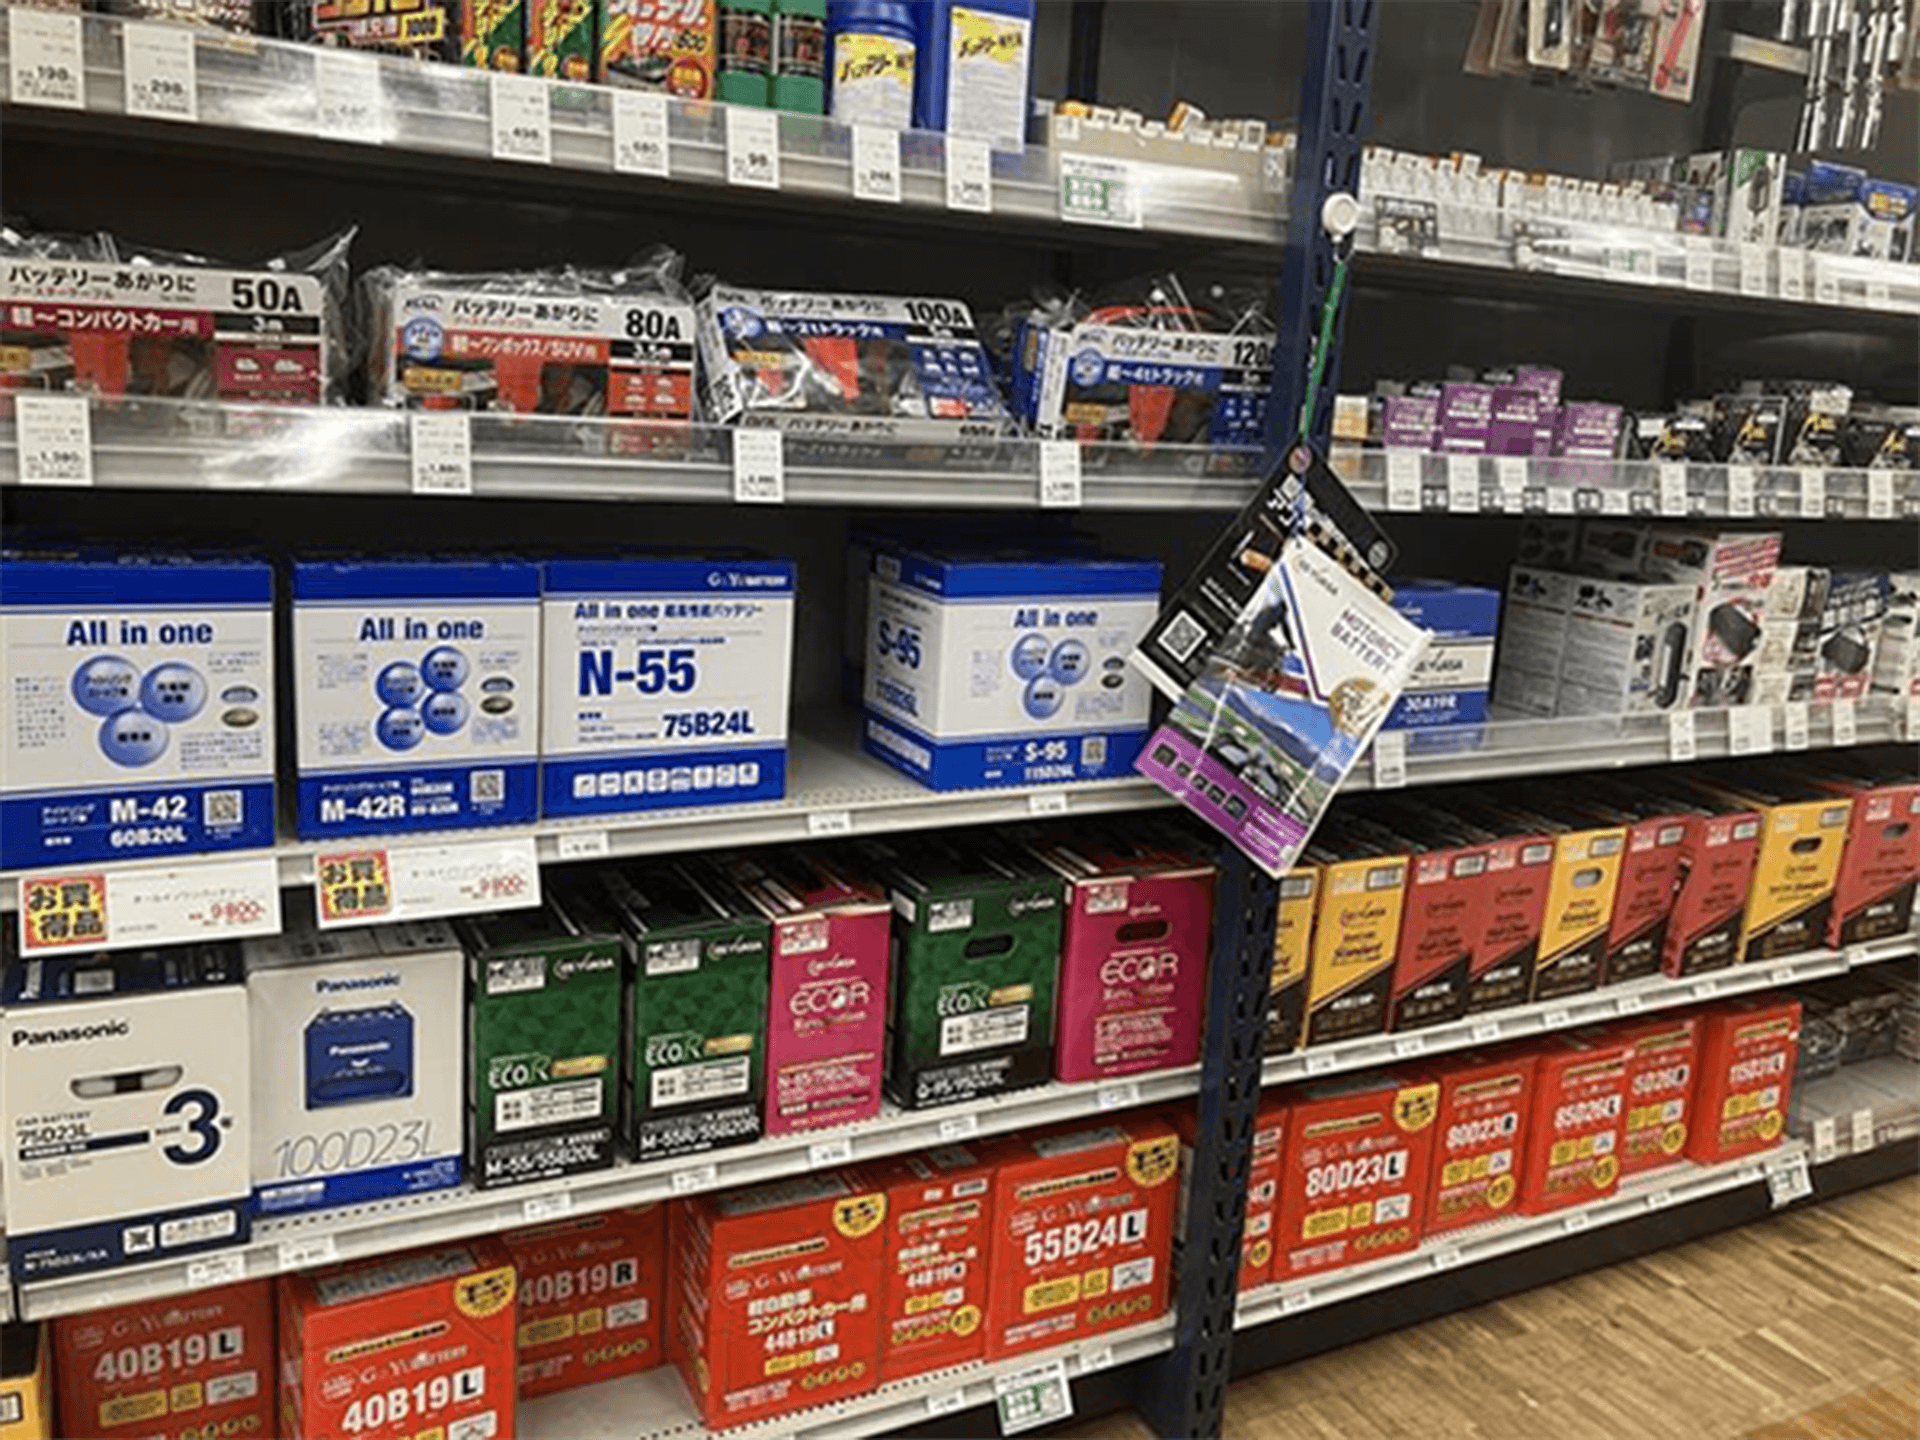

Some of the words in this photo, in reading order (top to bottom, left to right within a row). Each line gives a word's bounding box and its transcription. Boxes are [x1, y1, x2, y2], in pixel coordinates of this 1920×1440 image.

[9, 265, 196, 292] バッテリーあがりに
[232, 277, 302, 313] 50A
[453, 299, 600, 323] バッテリーあがりに
[625, 308, 682, 340] 80A
[904, 302, 968, 327] 100A
[575, 604, 599, 619] All
[605, 603, 621, 619] in
[627, 604, 659, 618] one
[1013, 609, 1038, 628] All
[1043, 608, 1061, 627] in
[1065, 610, 1098, 626] one
[66, 619, 109, 647] All
[120, 619, 148, 645] in
[158, 623, 214, 645] one
[359, 617, 395, 642] All
[404, 616, 428, 640] in
[437, 618, 484, 640] one
[578, 649, 696, 696] N-55
[663, 710, 755, 738] 75B24L
[1023, 740, 1068, 763] S-95
[109, 795, 189, 823] M-42
[319, 794, 407, 824] M-42R
[28, 882, 92, 912] お買
[316, 972, 401, 993] Panasonic
[11, 1019, 130, 1047] Panasonic
[16, 1124, 92, 1146] 75D23L
[163, 1087, 222, 1166] 3
[274, 1119, 442, 1178] 100D23L
[1305, 1150, 1408, 1198] 80D23L
[1024, 1209, 1146, 1268] 55B24L
[518, 1258, 639, 1306] 40B19R
[93, 1326, 243, 1383] 40B19L
[341, 1366, 485, 1433] 40B19L
